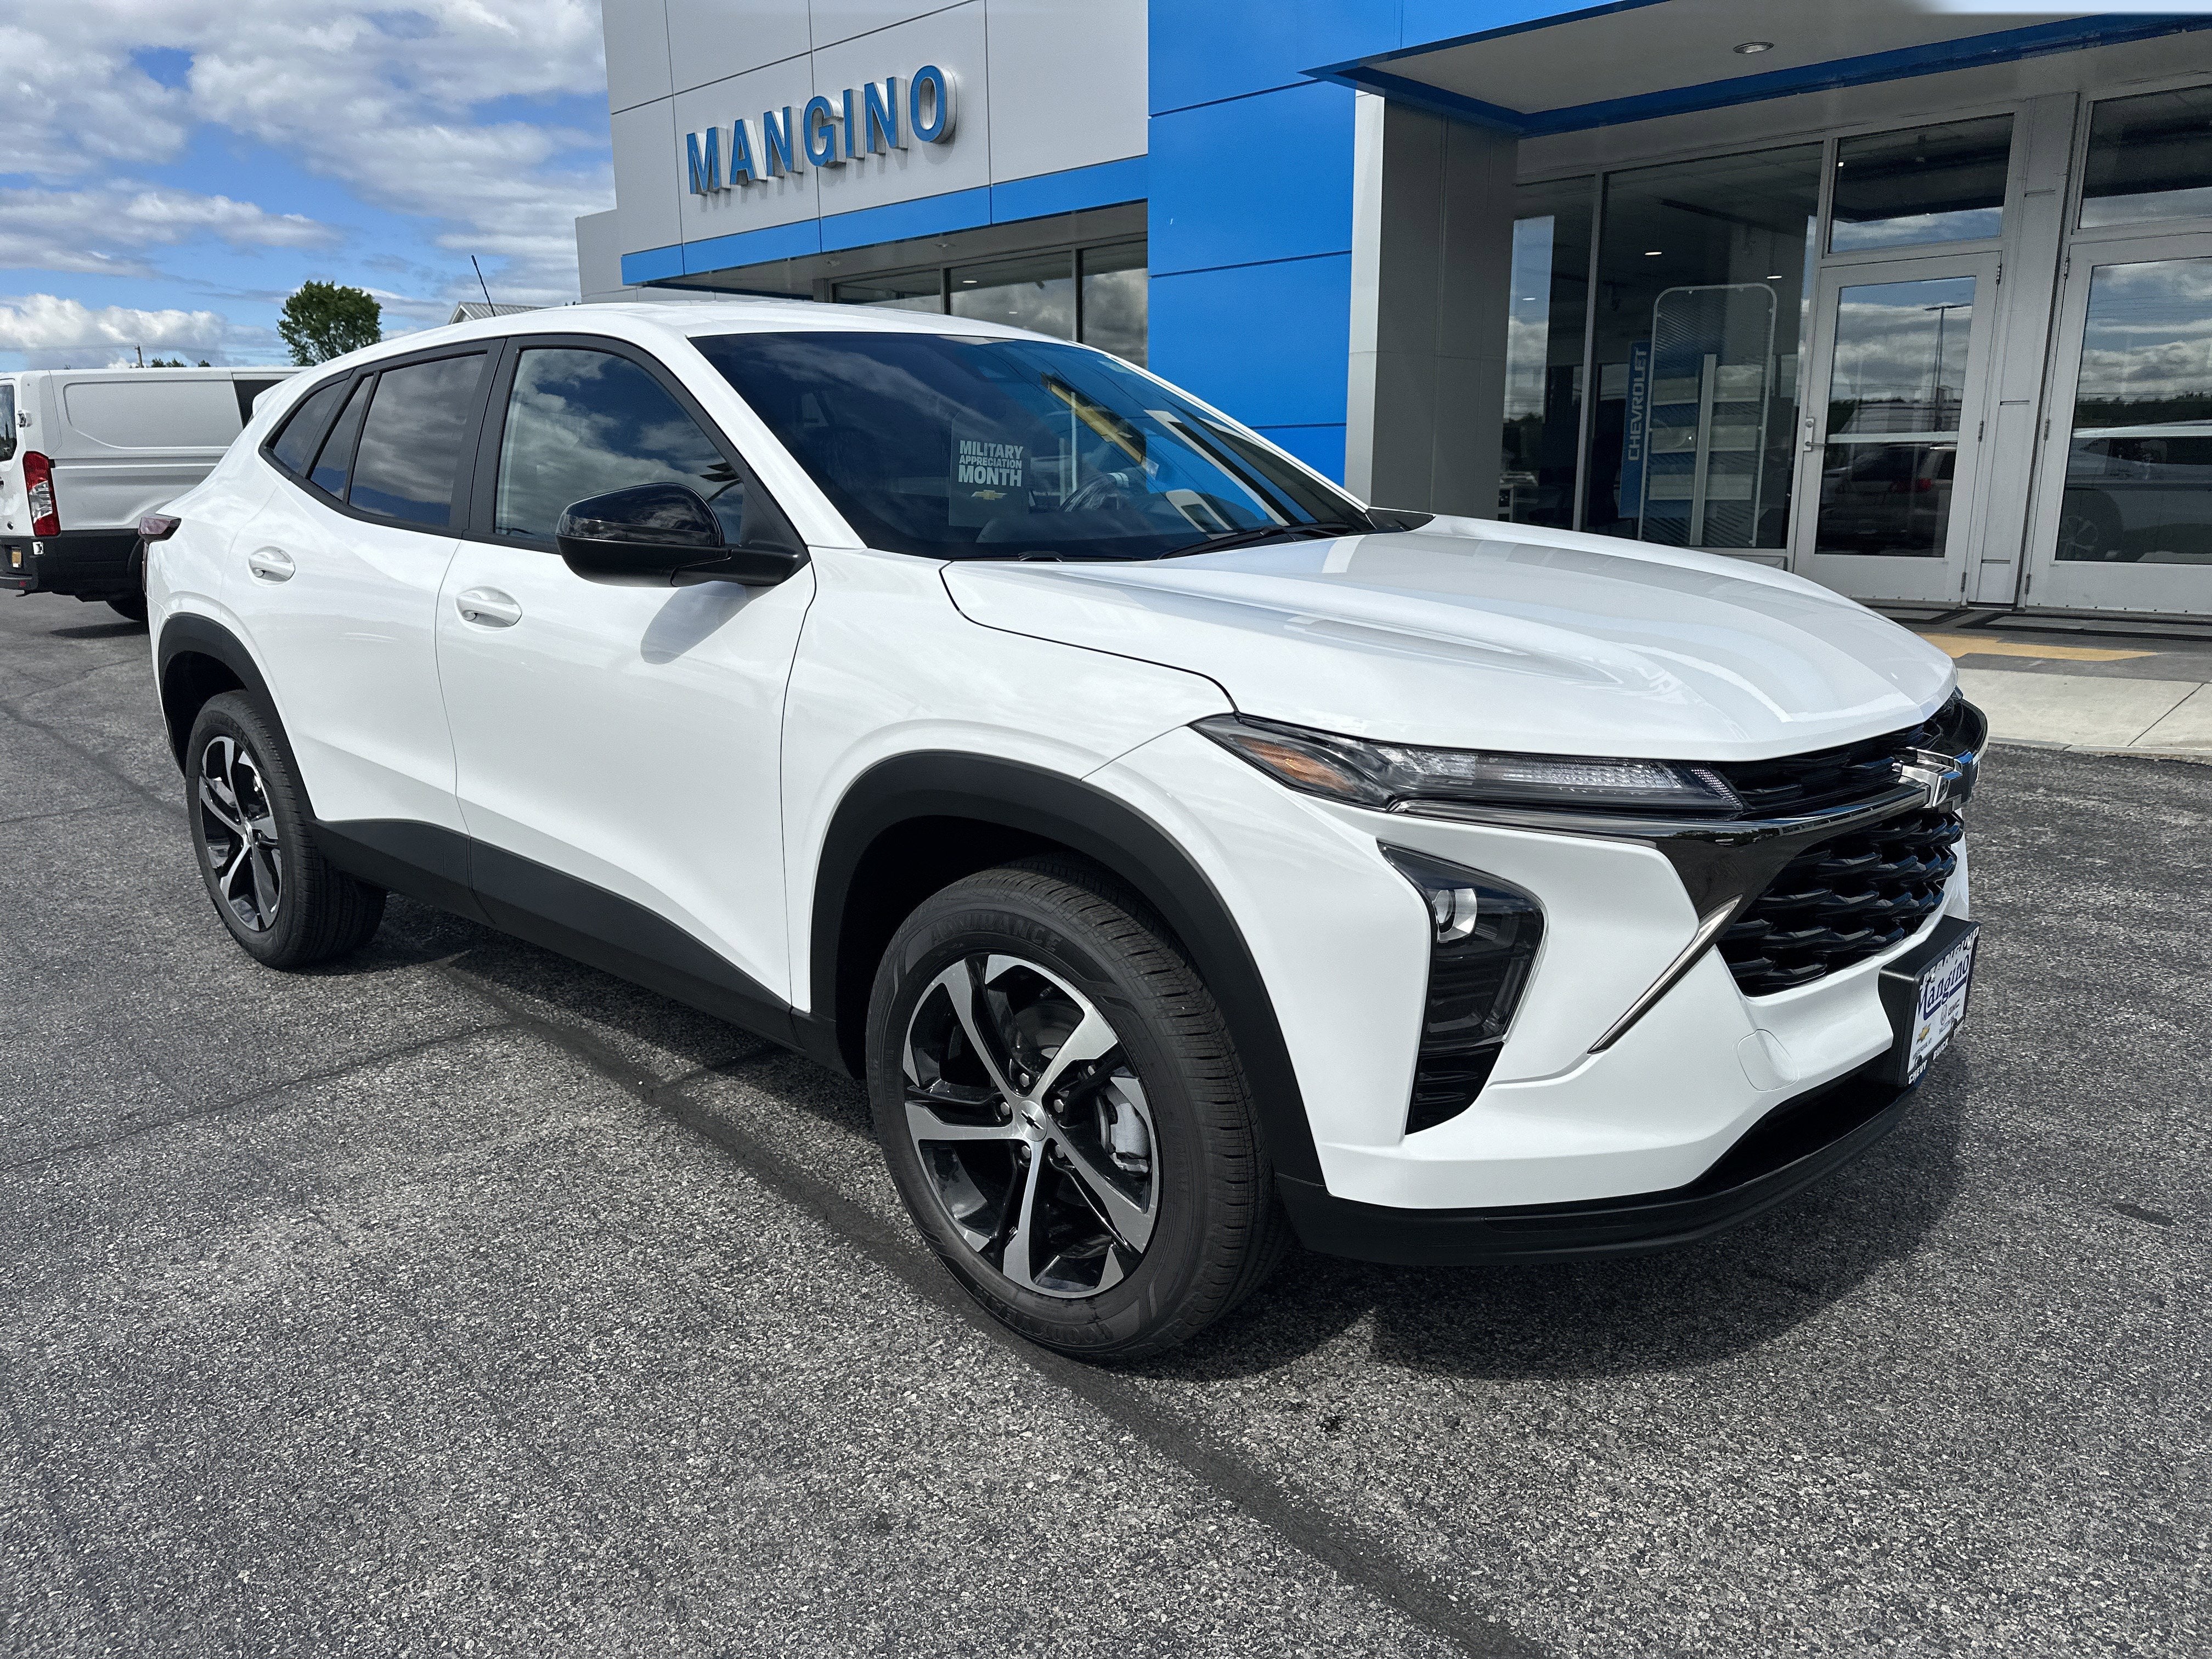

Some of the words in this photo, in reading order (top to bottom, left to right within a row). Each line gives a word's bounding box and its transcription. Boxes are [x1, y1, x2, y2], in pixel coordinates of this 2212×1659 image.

[686, 65, 955, 194] MANGINO
[1628, 346, 1647, 461] CHEVROLET
[960, 440, 1024, 460] MILITARY
[959, 454, 1022, 469] APPRECIATION
[958, 465, 1022, 487] MONTH
